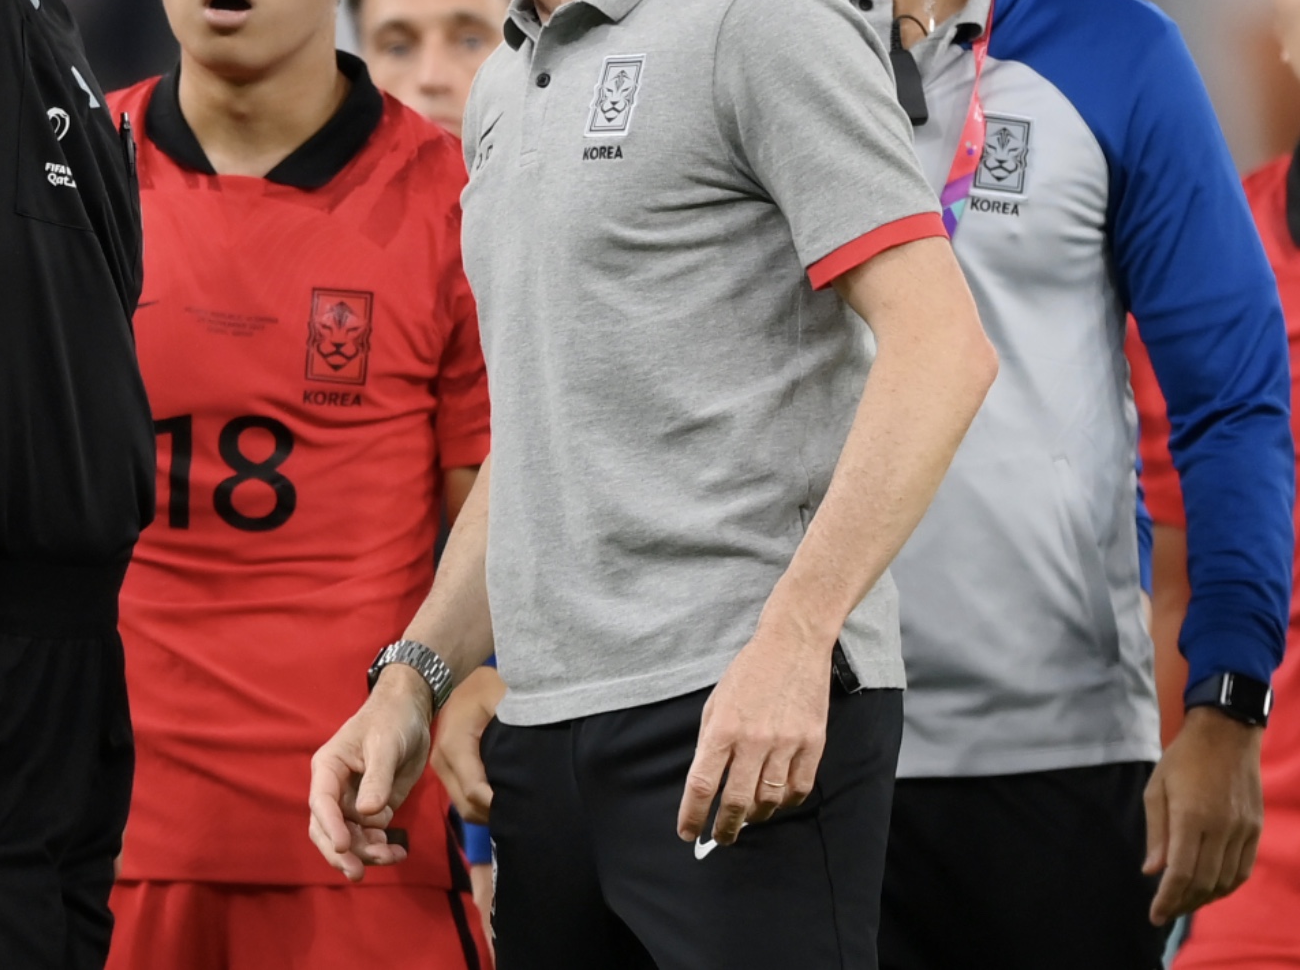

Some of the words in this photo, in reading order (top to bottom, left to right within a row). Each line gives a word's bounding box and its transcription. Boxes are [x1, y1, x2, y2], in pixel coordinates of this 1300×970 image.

[582, 145, 623, 161] KOREA
[44, 162, 66, 175] FIFA
[969, 198, 1020, 217] KOREA
[302, 390, 363, 408] KOREA
[154, 413, 297, 533] 18
